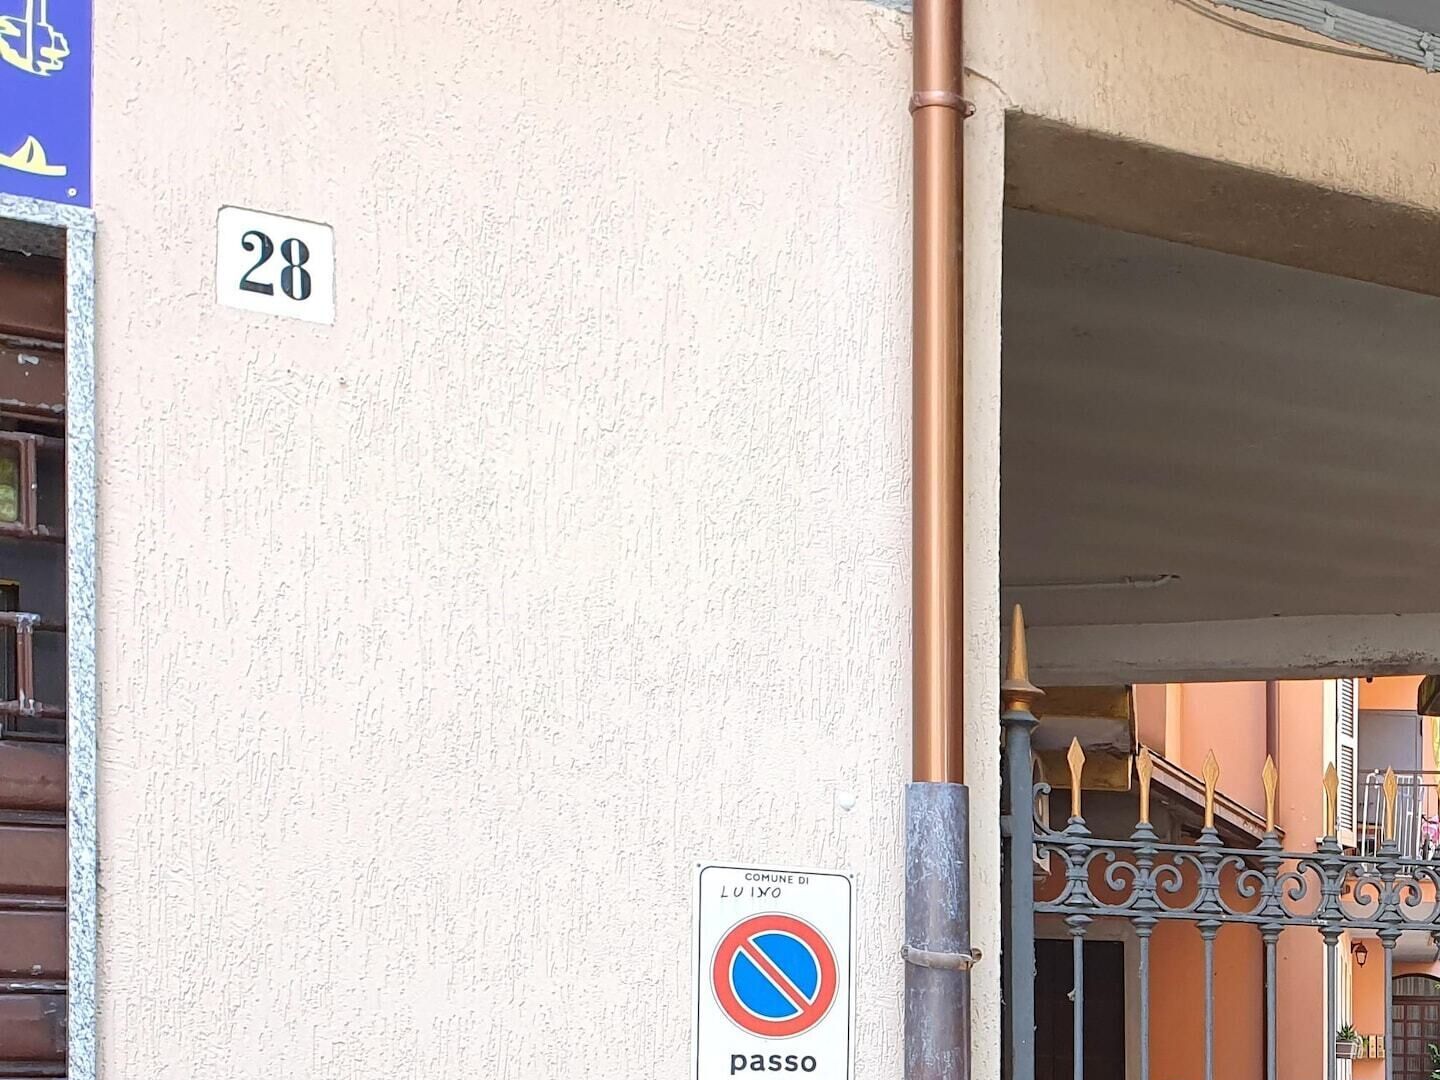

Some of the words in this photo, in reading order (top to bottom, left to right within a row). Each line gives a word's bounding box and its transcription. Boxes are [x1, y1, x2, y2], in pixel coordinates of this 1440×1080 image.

[239, 230, 311, 301] 28
[745, 873, 793, 884] COMUNE
[799, 876, 809, 885] DI
[721, 885, 782, 898] LUINO
[731, 1054, 817, 1075] passo
